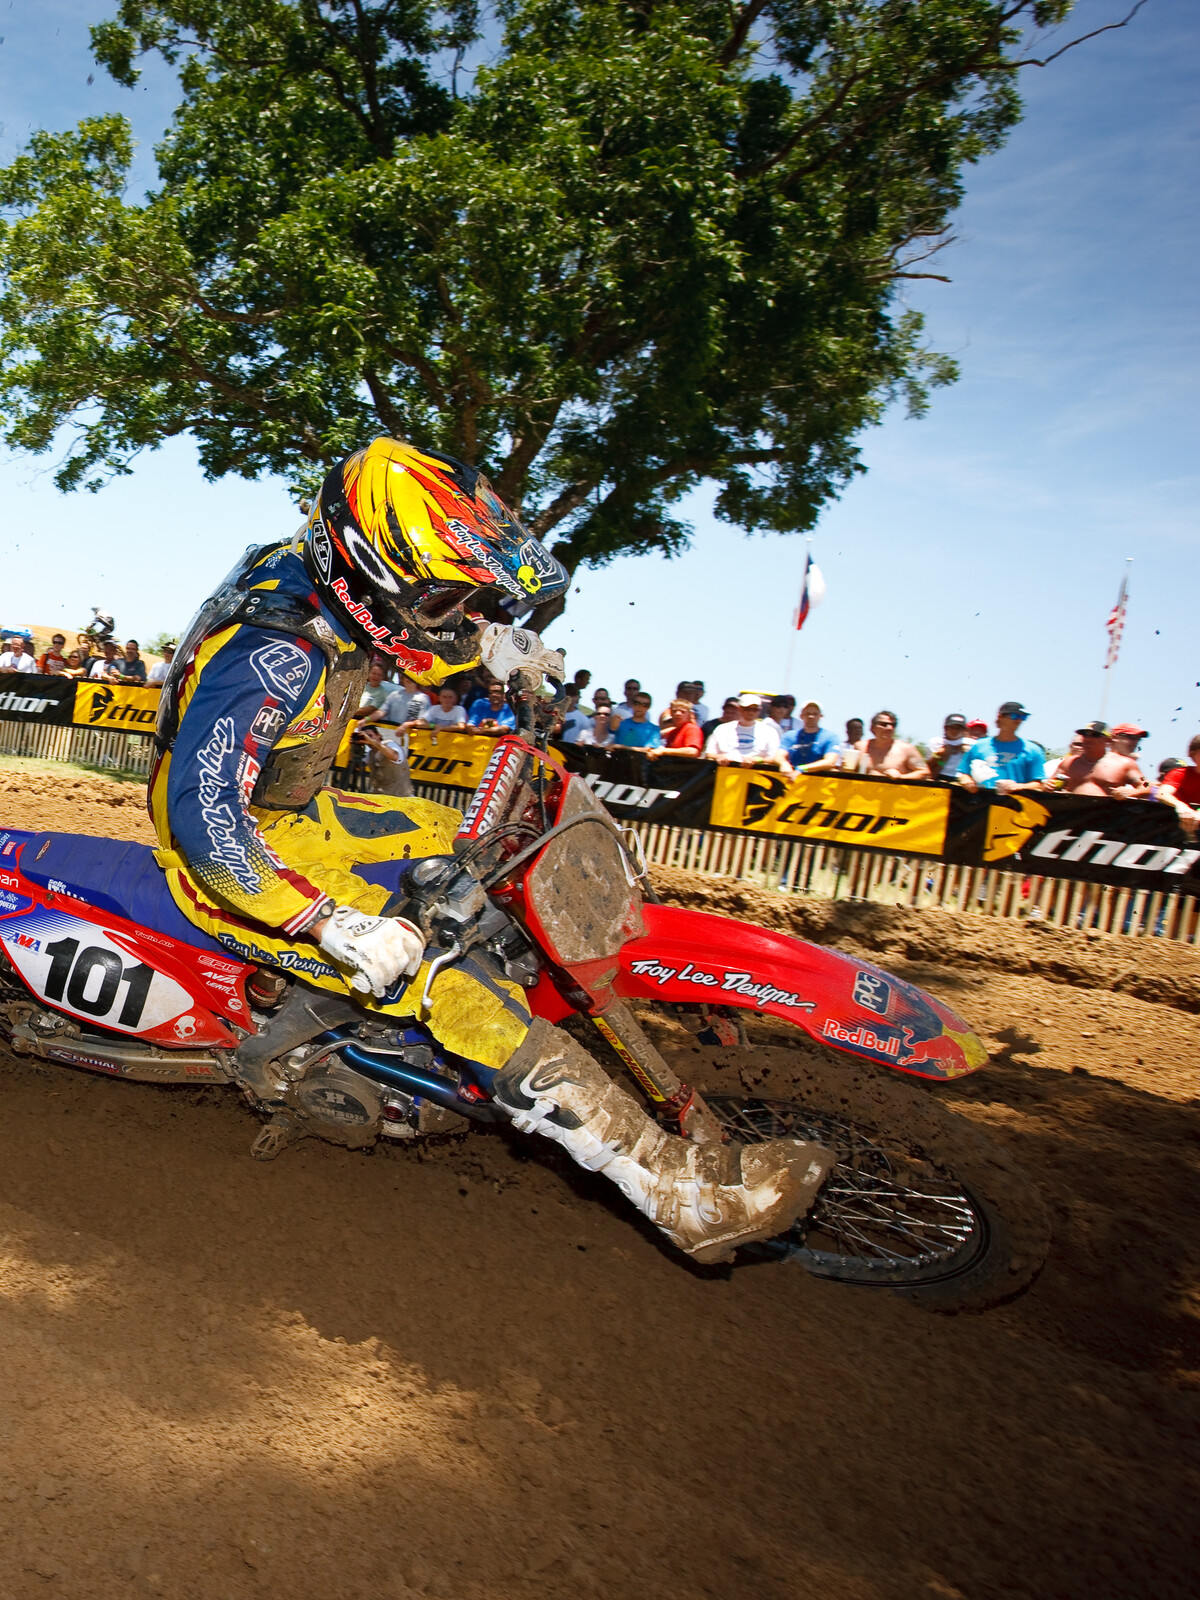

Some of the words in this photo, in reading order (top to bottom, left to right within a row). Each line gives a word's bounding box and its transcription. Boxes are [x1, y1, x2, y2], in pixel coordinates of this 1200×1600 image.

[448, 519, 473, 544] Troy
[466, 540, 489, 563] Lee
[483, 556, 527, 600] Designs
[107, 704, 157, 724] tho
[197, 716, 235, 774] Troy
[408, 749, 473, 774] hor
[198, 768, 229, 807] Lee
[458, 745, 507, 834] RENTHAL
[584, 773, 681, 808] hor
[777, 801, 909, 834] thor
[202, 803, 263, 895] Designs
[7, 932, 41, 953] AMA
[44, 937, 155, 1028] 101
[631, 959, 676, 985] Troy
[676, 963, 718, 987] Lee
[719, 972, 817, 1007] Designs
[185, 1066, 214, 1076] RK
[616, 1047, 661, 1097] SHOWA
